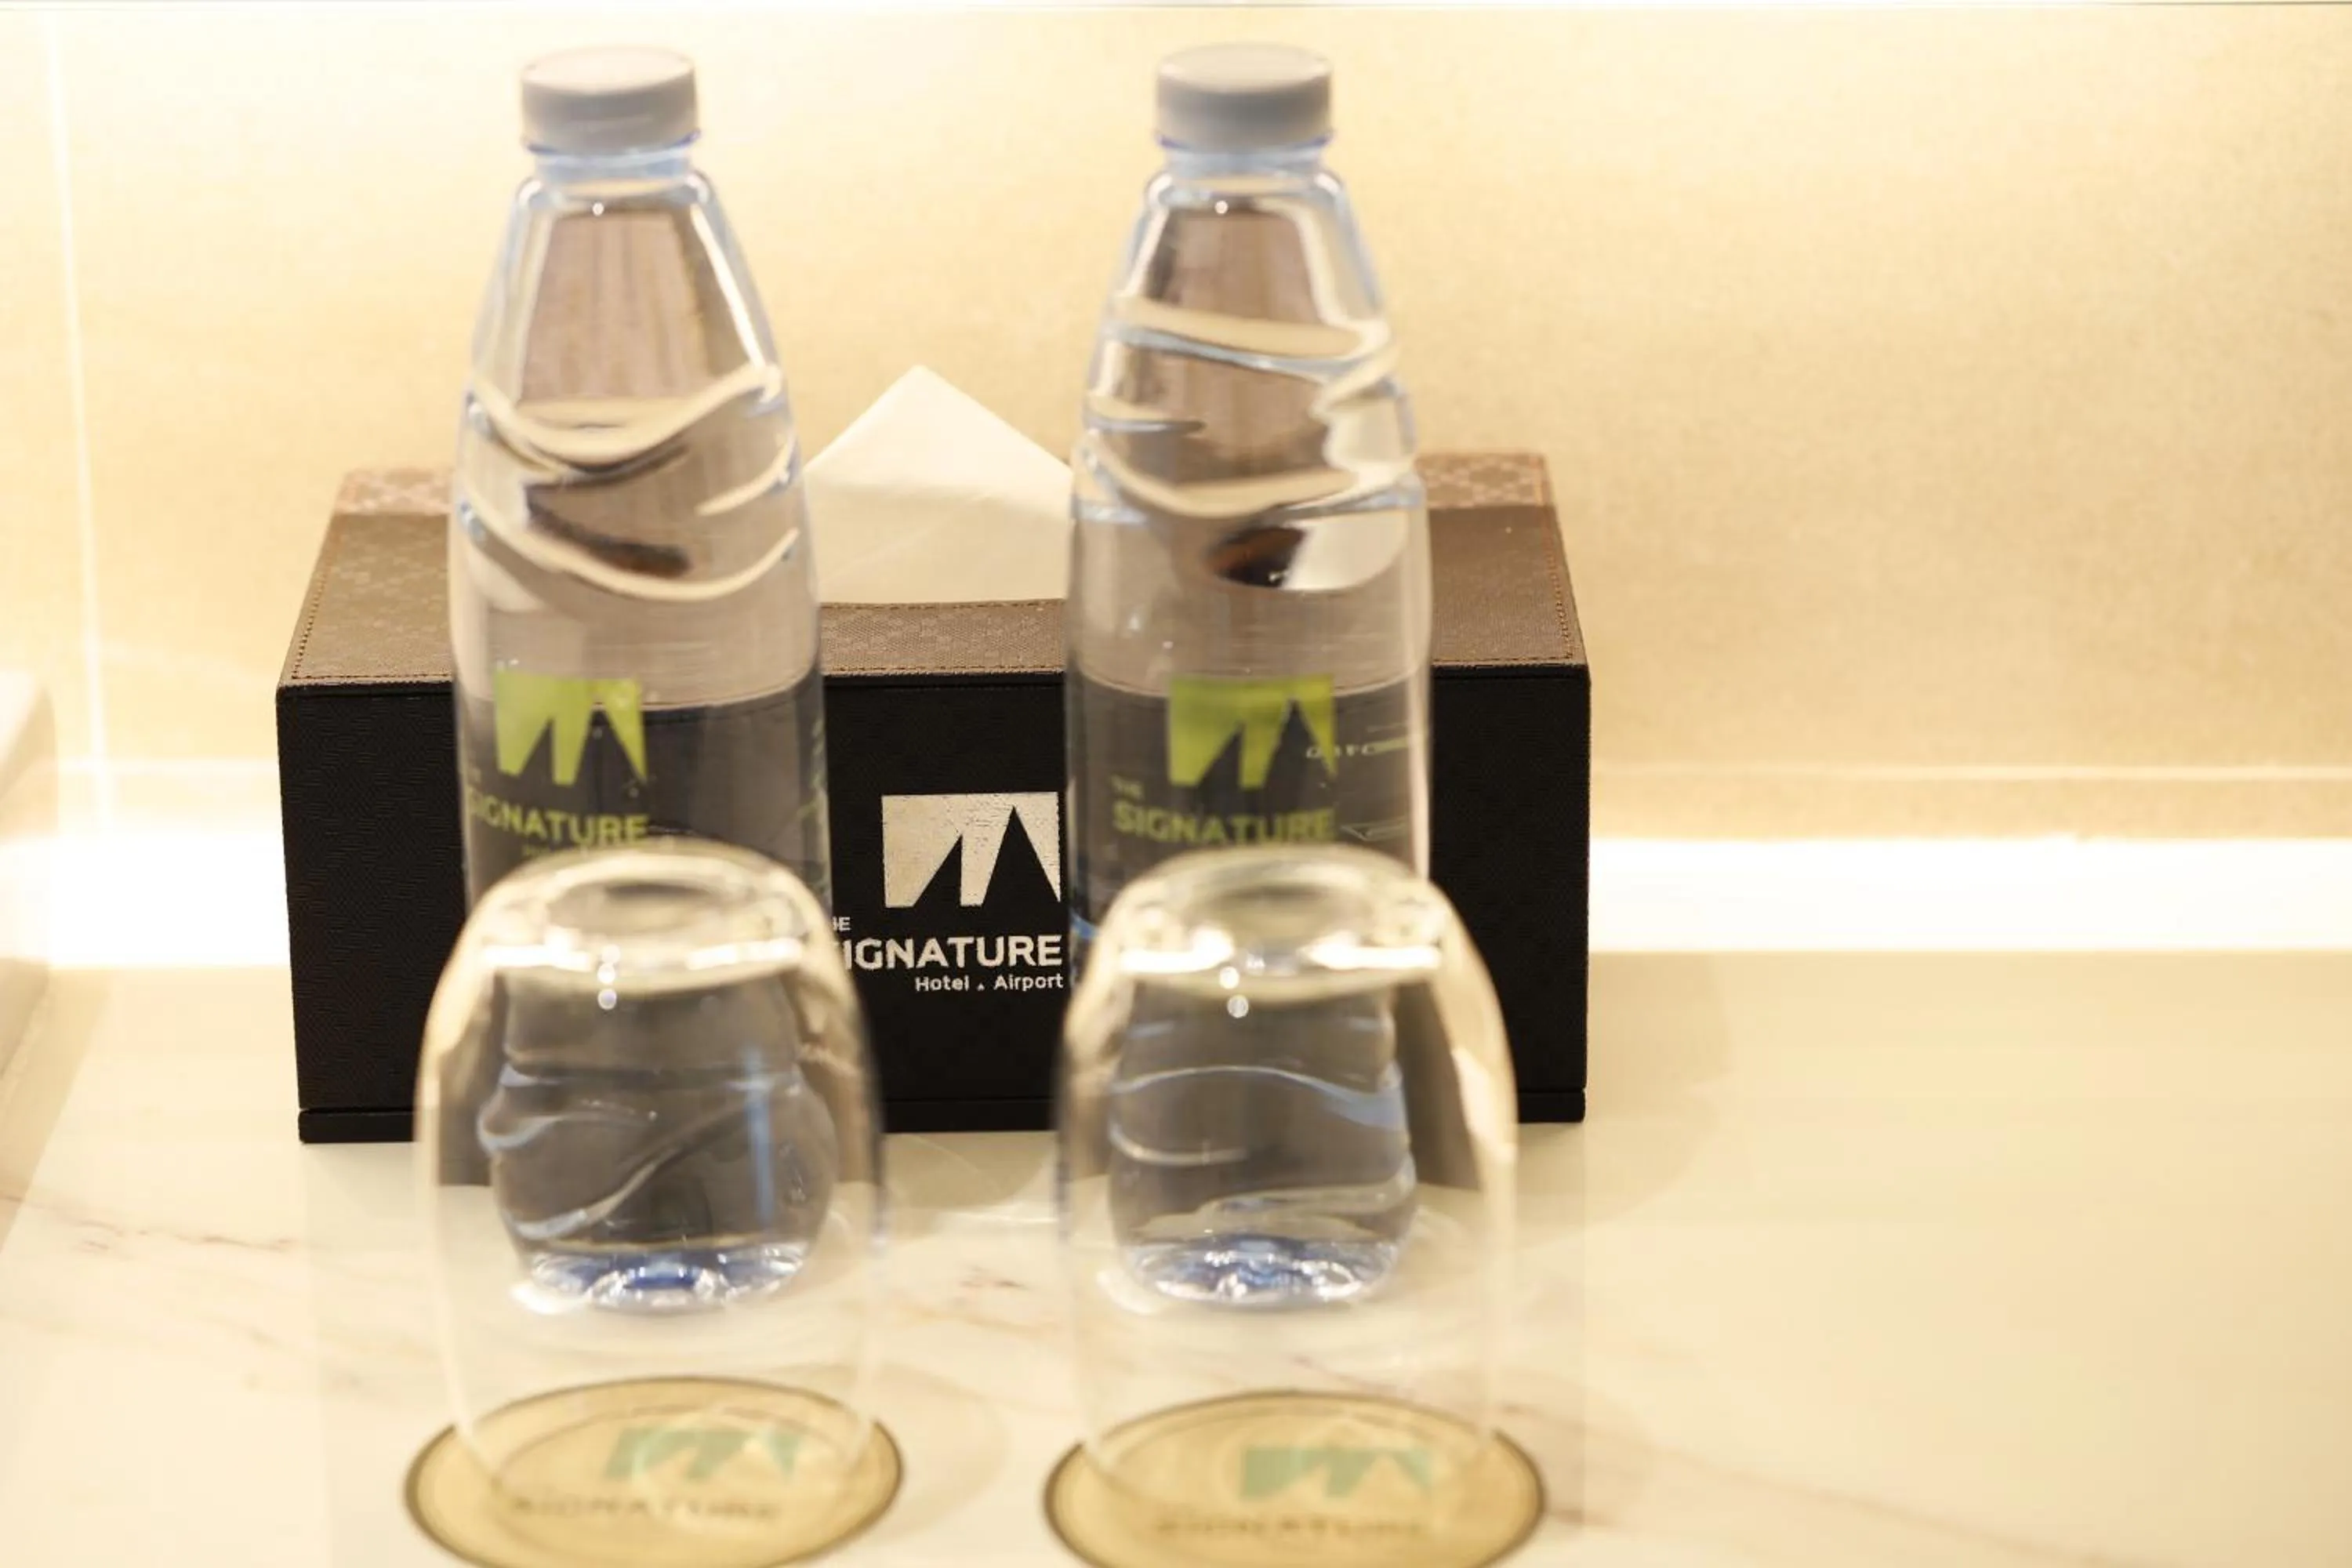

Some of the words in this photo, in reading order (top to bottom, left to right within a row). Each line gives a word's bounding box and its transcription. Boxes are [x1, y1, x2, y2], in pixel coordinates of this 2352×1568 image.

[1112, 799, 1335, 845] SIGNATURE
[844, 935, 1062, 971] IGNATURE
[915, 976, 969, 992] Hotel
[993, 973, 1064, 992] Airport
